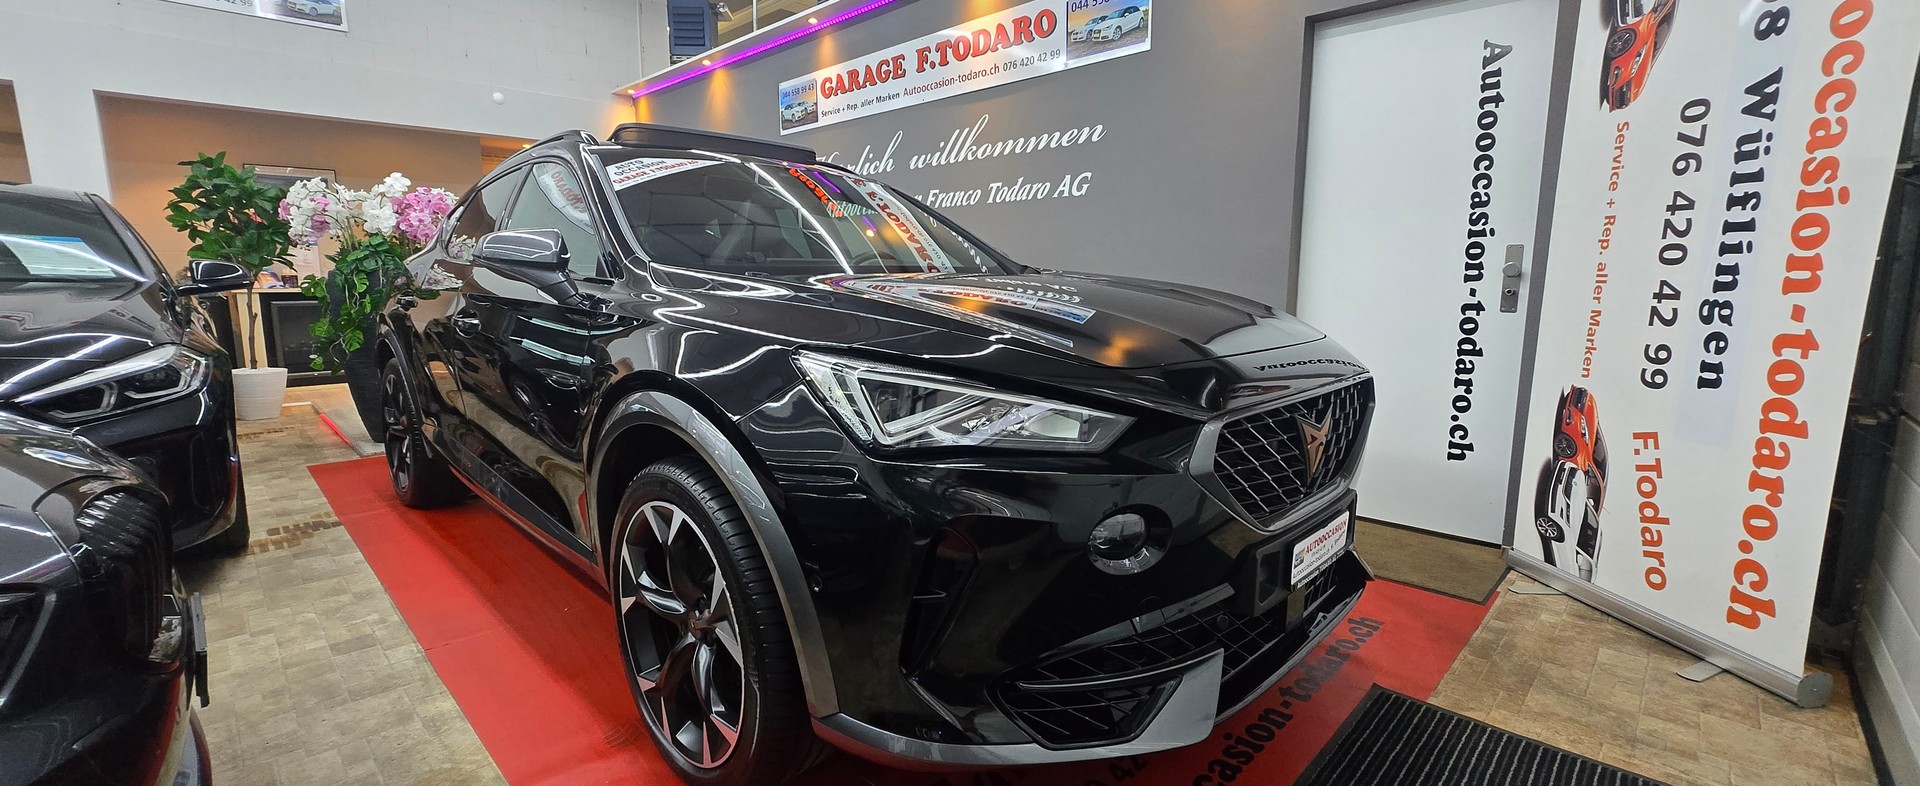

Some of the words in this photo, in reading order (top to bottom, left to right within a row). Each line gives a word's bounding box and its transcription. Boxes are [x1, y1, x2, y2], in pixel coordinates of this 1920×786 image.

[1754, 0, 1790, 41] 8
[820, 54, 906, 99] GARAGE
[915, 8, 1058, 74] F.TODARO
[903, 63, 1000, 97] Autooccasion-todaro.ch
[1002, 60, 1018, 72] 076
[1019, 56, 1035, 68] 420
[1036, 53, 1048, 63] 42
[1050, 48, 1061, 60] 99
[791, 88, 800, 97] 558
[808, 83, 815, 92] 43
[821, 106, 841, 118] Service
[846, 103, 860, 112] Rep.
[860, 98, 874, 107] aller
[875, 92, 900, 104] Marken
[908, 114, 1107, 171] willkommen
[1608, 121, 1630, 192] Service
[1672, 98, 1711, 176] 076
[615, 160, 644, 170] AUTO
[926, 189, 981, 209] Franco
[987, 177, 1051, 204] Todaro
[1053, 172, 1092, 198] AG
[1606, 198, 1615, 208] +
[1447, 38, 1513, 462] Autooccasion-todaro.ch
[1598, 214, 1616, 256] Rep.
[1657, 190, 1696, 266] 420
[1697, 66, 1783, 390] Wülflingen
[1593, 261, 1609, 304] aller
[1648, 279, 1682, 328] 42
[1581, 309, 1602, 379] Marken
[1640, 343, 1672, 390] 99
[1632, 430, 1670, 591] F.Todaro
